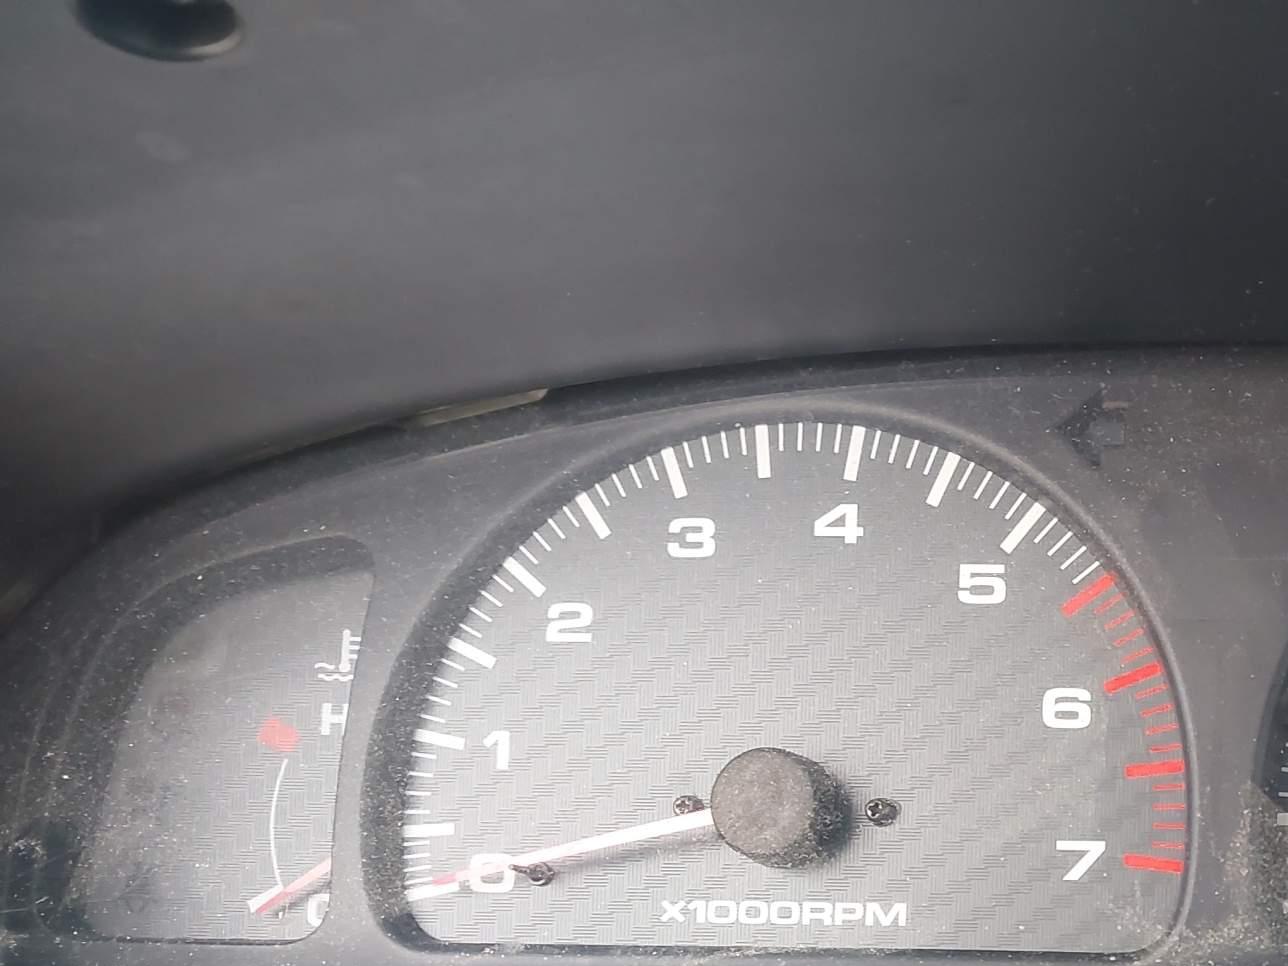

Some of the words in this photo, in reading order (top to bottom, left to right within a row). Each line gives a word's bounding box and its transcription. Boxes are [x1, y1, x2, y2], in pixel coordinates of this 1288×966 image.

[667, 518, 715, 557] 3
[814, 504, 863, 543] 4
[957, 564, 1007, 604] 5
[546, 602, 592, 642] 2
[320, 703, 349, 735] H
[1042, 688, 1092, 728] 6
[483, 731, 510, 769] 1
[470, 854, 515, 893] 0
[1055, 841, 1106, 881] 7
